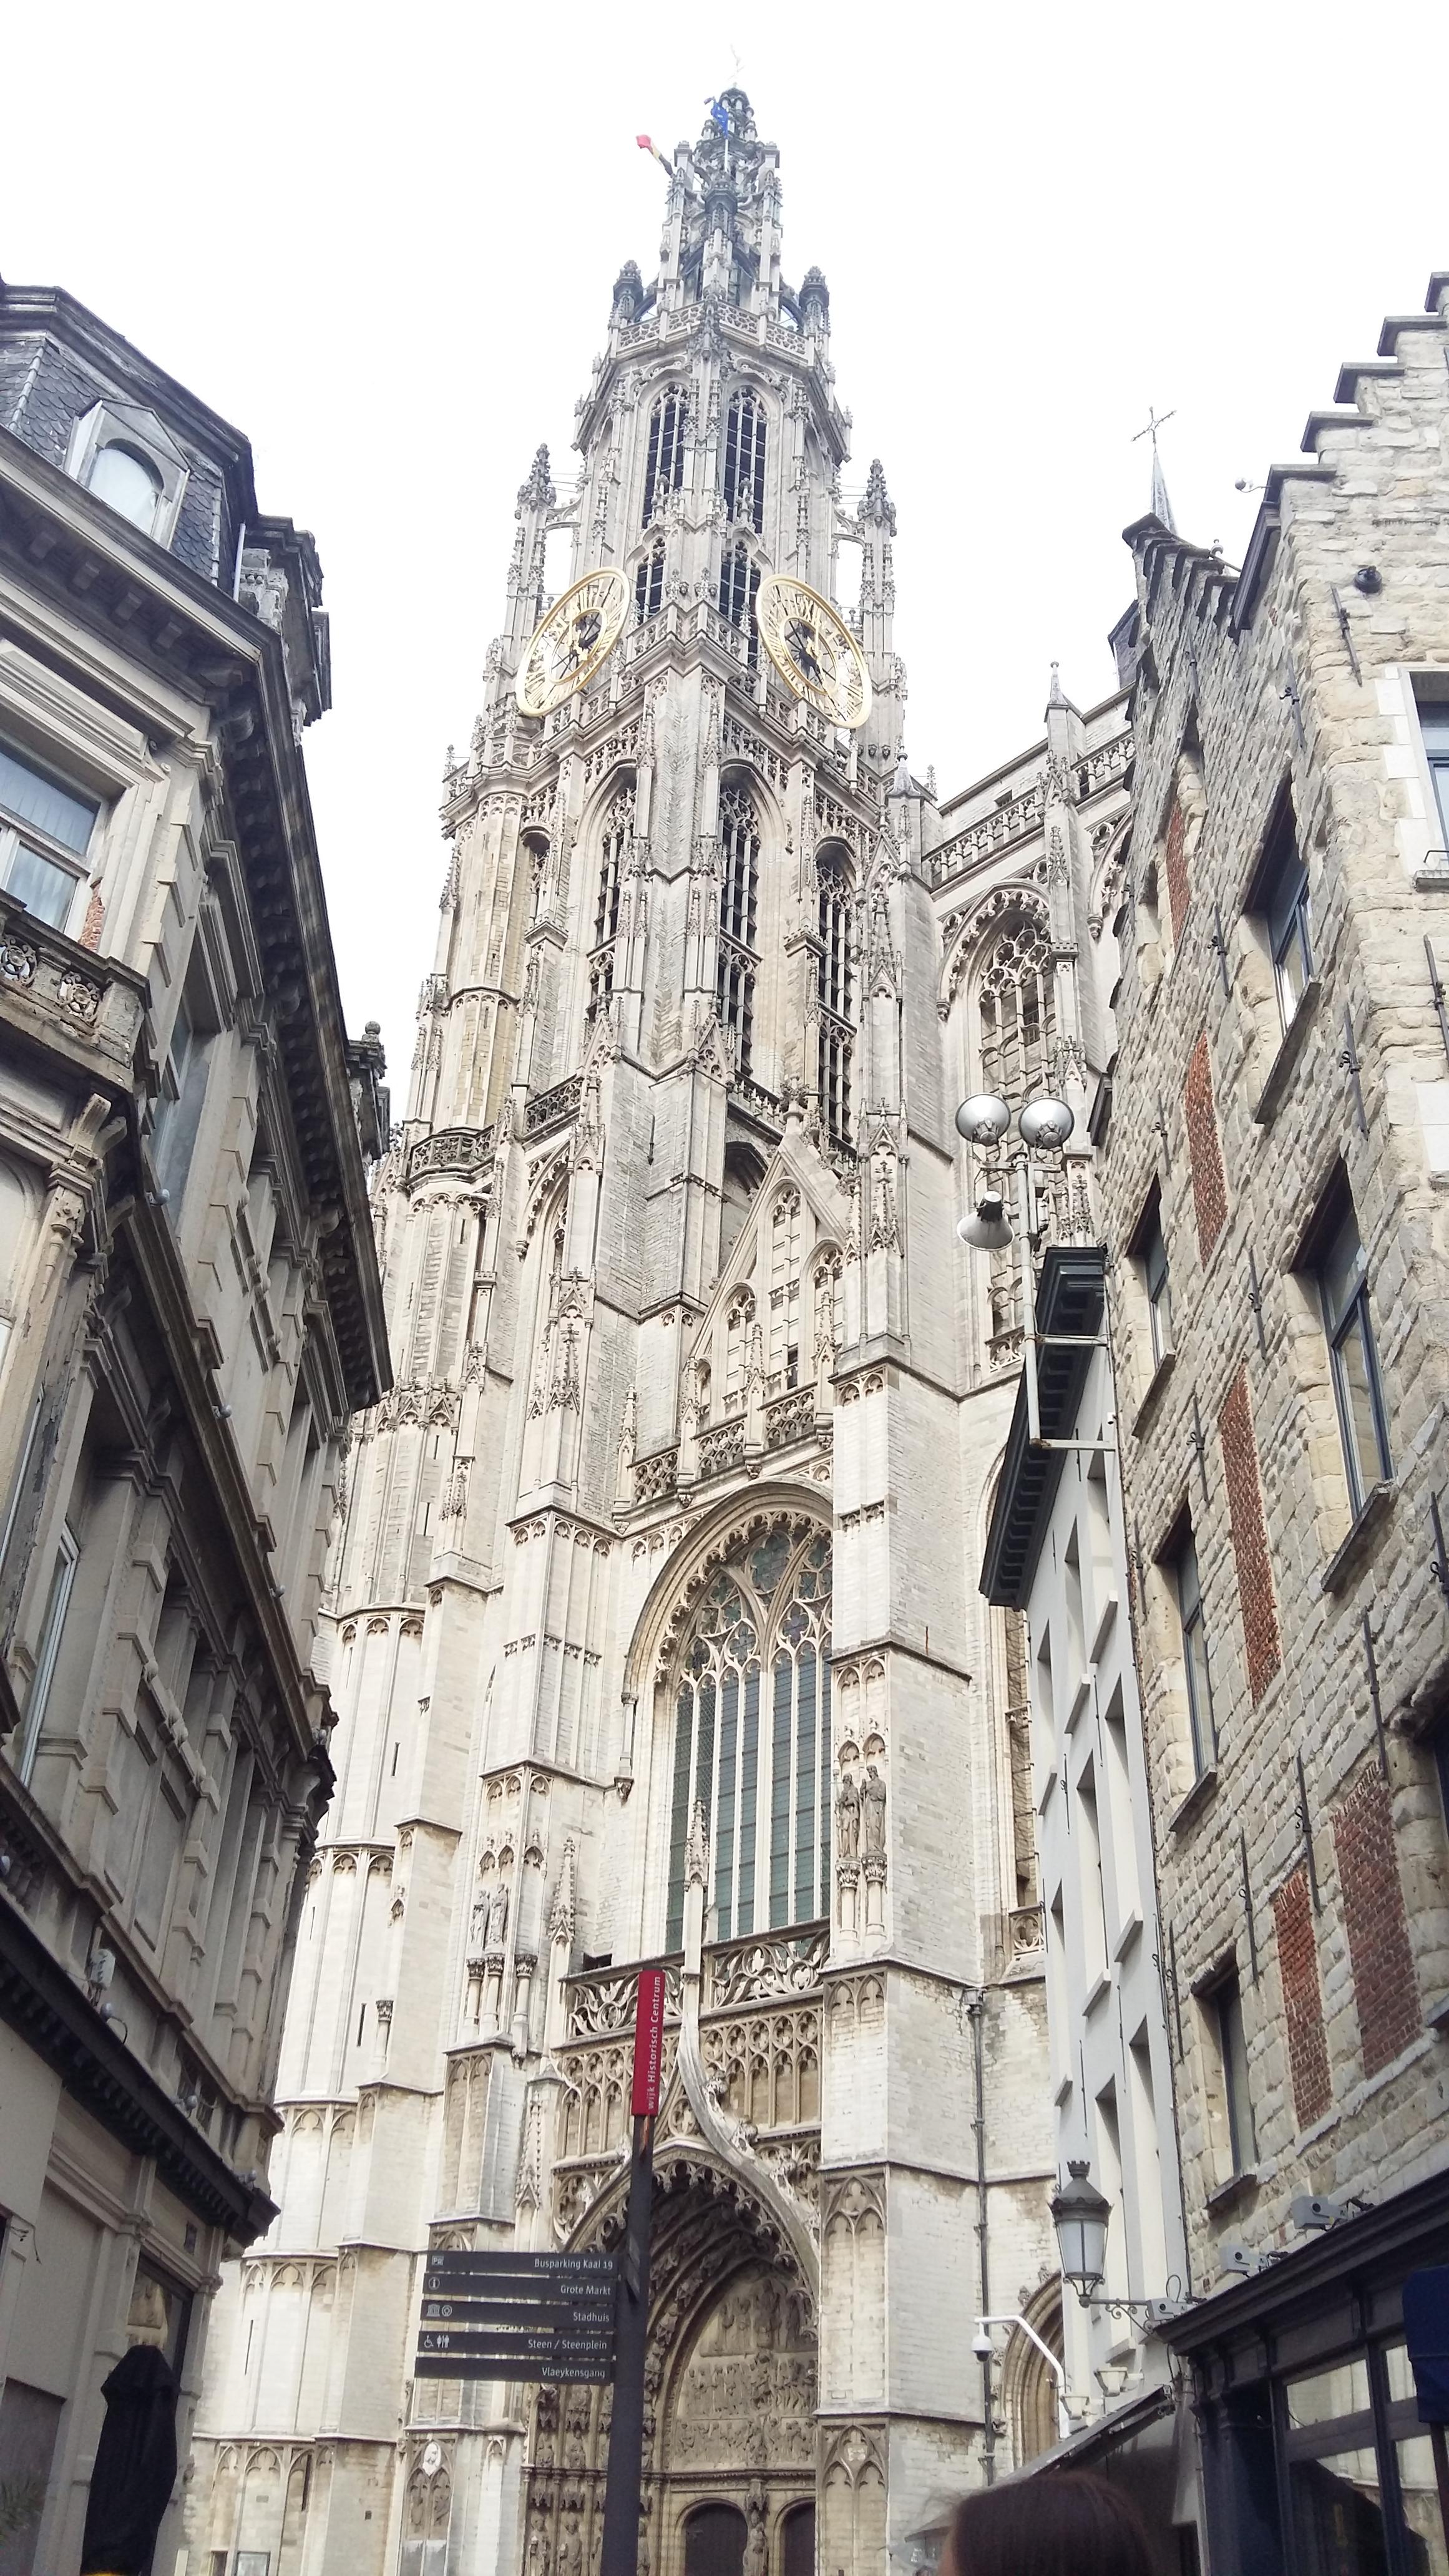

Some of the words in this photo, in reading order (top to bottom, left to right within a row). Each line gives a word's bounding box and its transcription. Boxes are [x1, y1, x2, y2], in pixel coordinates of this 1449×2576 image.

[650, 1976, 661, 2022] Centrum
[648, 2026, 658, 2082] Historisch
[534, 2258, 581, 2270] Busparking
[583, 2260, 600, 2268] Kaal
[603, 2260, 613, 2270] 19
[560, 2285, 583, 2294] Grote
[586, 2285, 611, 2295] Markt
[573, 2311, 610, 2322] Stadhuis
[528, 2339, 552, 2348] Steen
[562, 2339, 607, 2351] Steenplein
[542, 2366, 605, 2378] Vlaeykensgang
